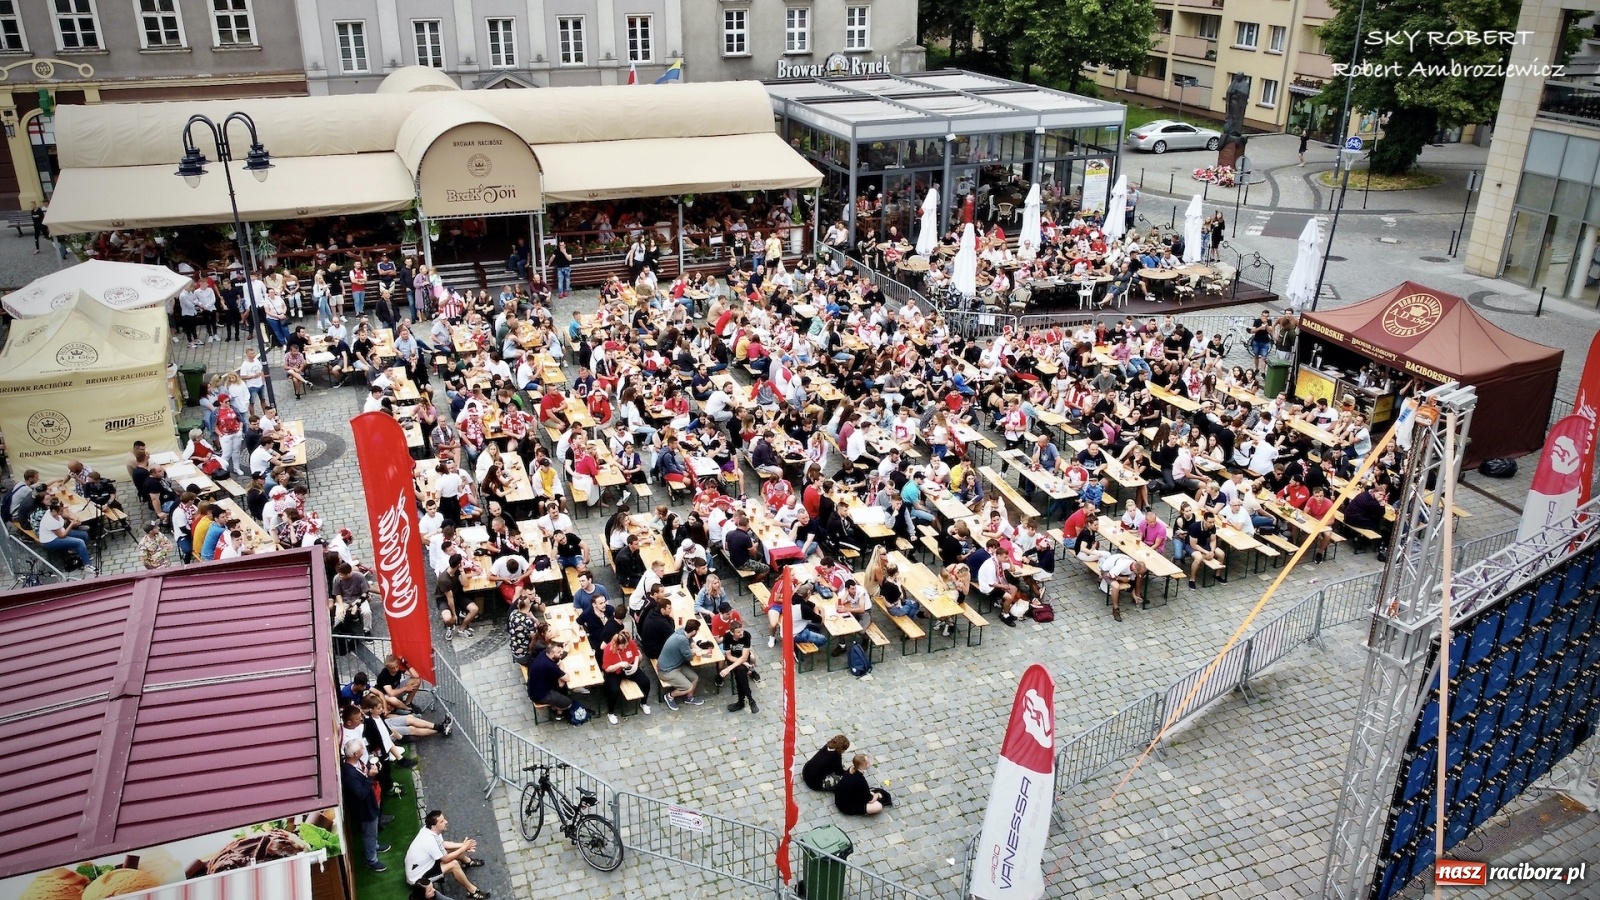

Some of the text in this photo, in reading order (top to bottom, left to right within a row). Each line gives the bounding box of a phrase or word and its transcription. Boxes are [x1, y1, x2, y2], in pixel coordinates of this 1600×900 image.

[777, 55, 891, 78] Browar Rynek
[477, 138, 503, 146] RACIBÓRZ
[1302, 318, 1345, 342] RACIBORSKIE
[33, 381, 73, 391] RACIBÓRZ
[86, 370, 159, 385] BROWAR RACIBÓRZ
[19, 445, 92, 458] BROWAR RACIBÓRZ
[379, 487, 419, 619] Coca-Cola
[999, 776, 1032, 889] VANESSA
[990, 844, 1001, 885] RADIO
